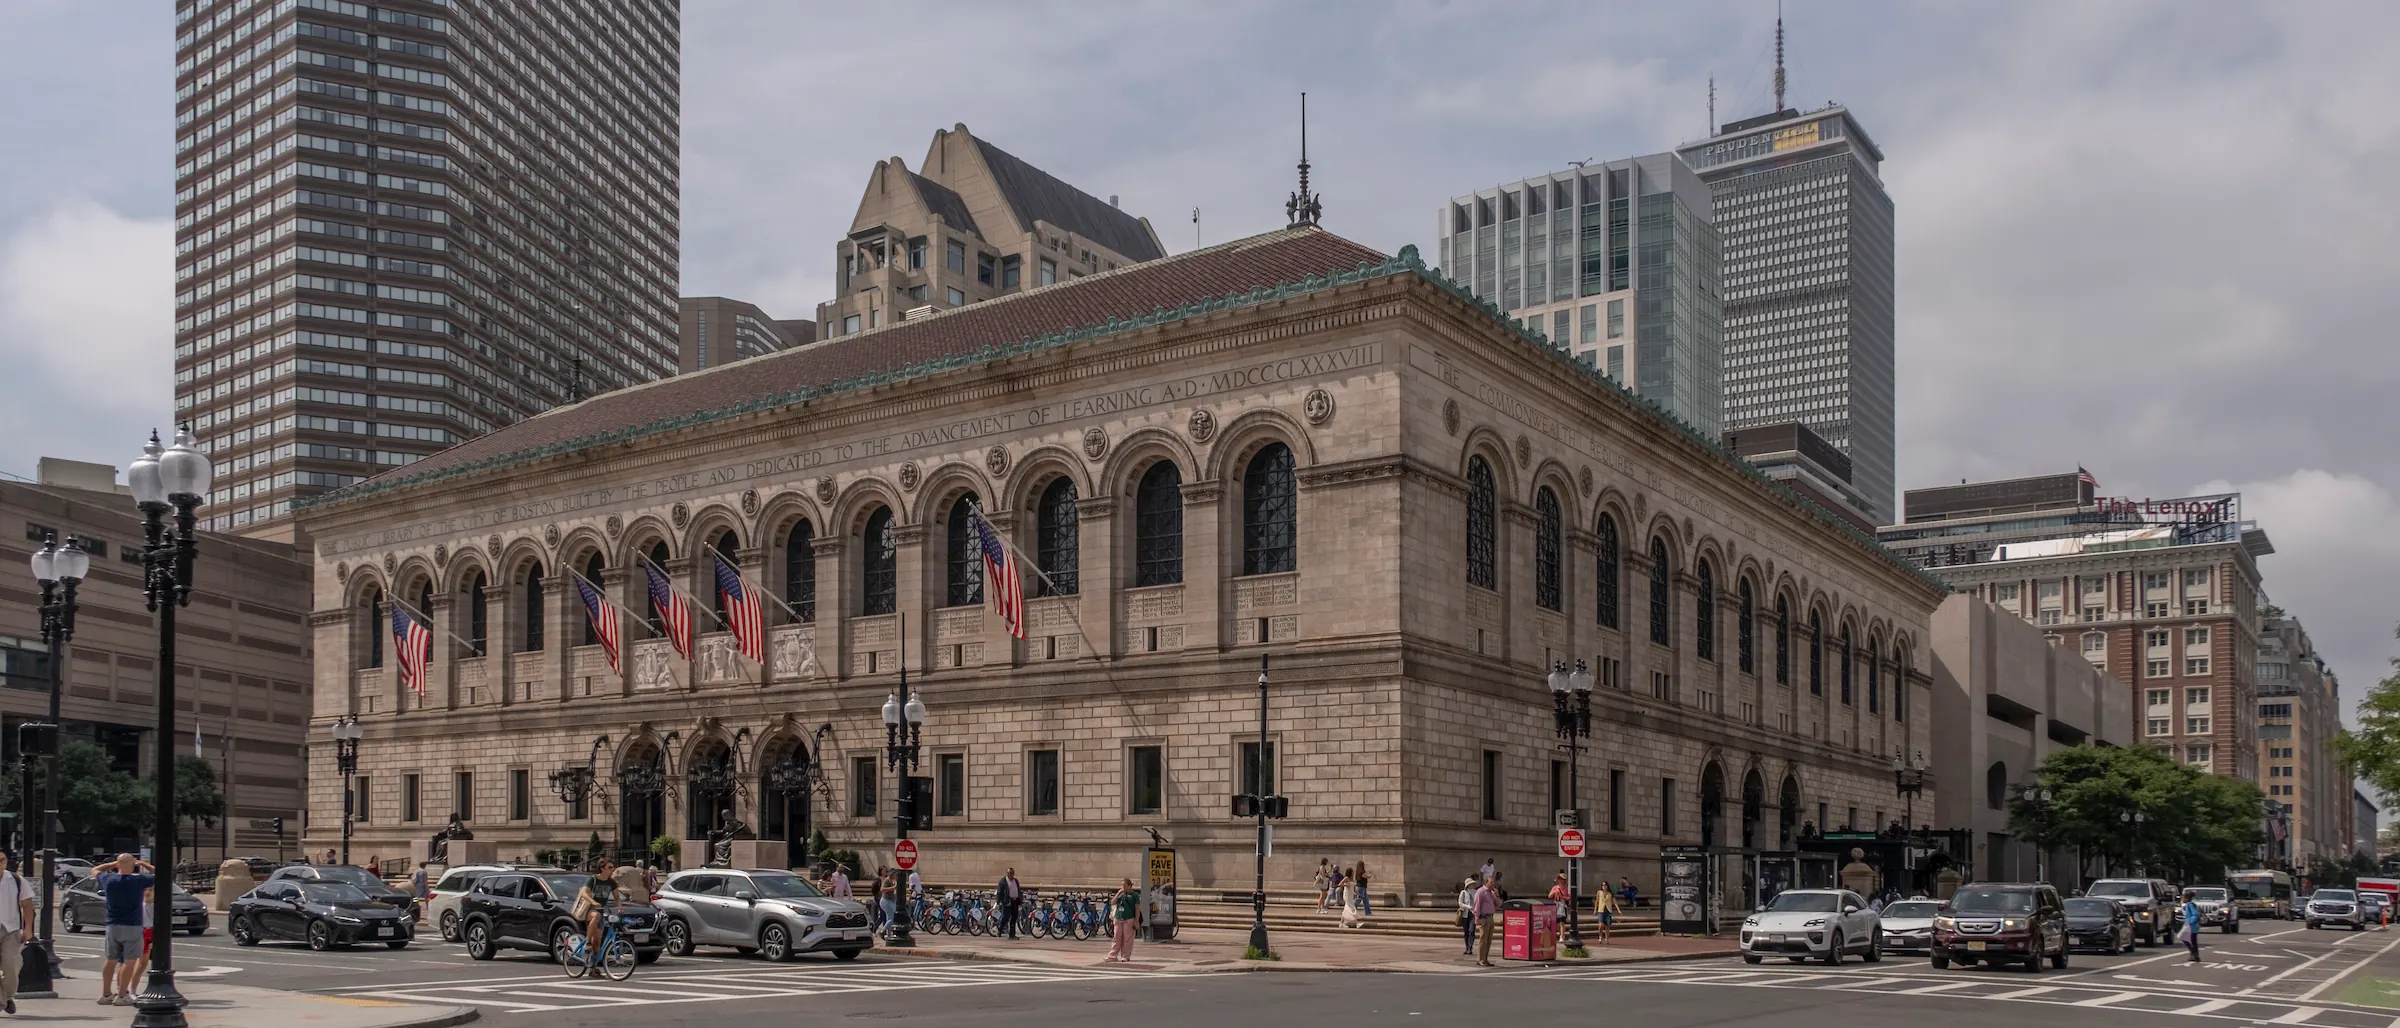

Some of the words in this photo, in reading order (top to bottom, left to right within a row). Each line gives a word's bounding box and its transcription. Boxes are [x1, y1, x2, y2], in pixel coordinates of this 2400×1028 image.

[1435, 359, 1461, 389] THE
[1479, 384, 1577, 448] COMMONWEALTH
[1590, 440, 1635, 478] REQUIRES
[1646, 470, 1664, 492] THE
[377, 526, 414, 545] LIBRARY
[420, 523, 432, 537] OF
[438, 519, 456, 533] THE
[462, 514, 485, 530] CITY
[493, 509, 507, 523] OF
[512, 501, 556, 521] BOSTON
[562, 493, 593, 510] BUILT
[600, 488, 614, 504] BY
[624, 483, 647, 500] THE
[656, 473, 699, 494] PEOPLE
[709, 467, 736, 484] AND
[747, 451, 822, 478] DEDICATED
[837, 444, 853, 461] TO
[862, 437, 891, 456] THE
[901, 413, 1017, 449] ADVANCEMENT
[1028, 407, 1050, 426] OF
[1063, 388, 1152, 420] LEARNING
[2094, 497, 2137, 514] The
[2145, 498, 2216, 515] Lenox
[1151, 859, 1171, 869] FAVE
[2170, 961, 2270, 972] ONLY
